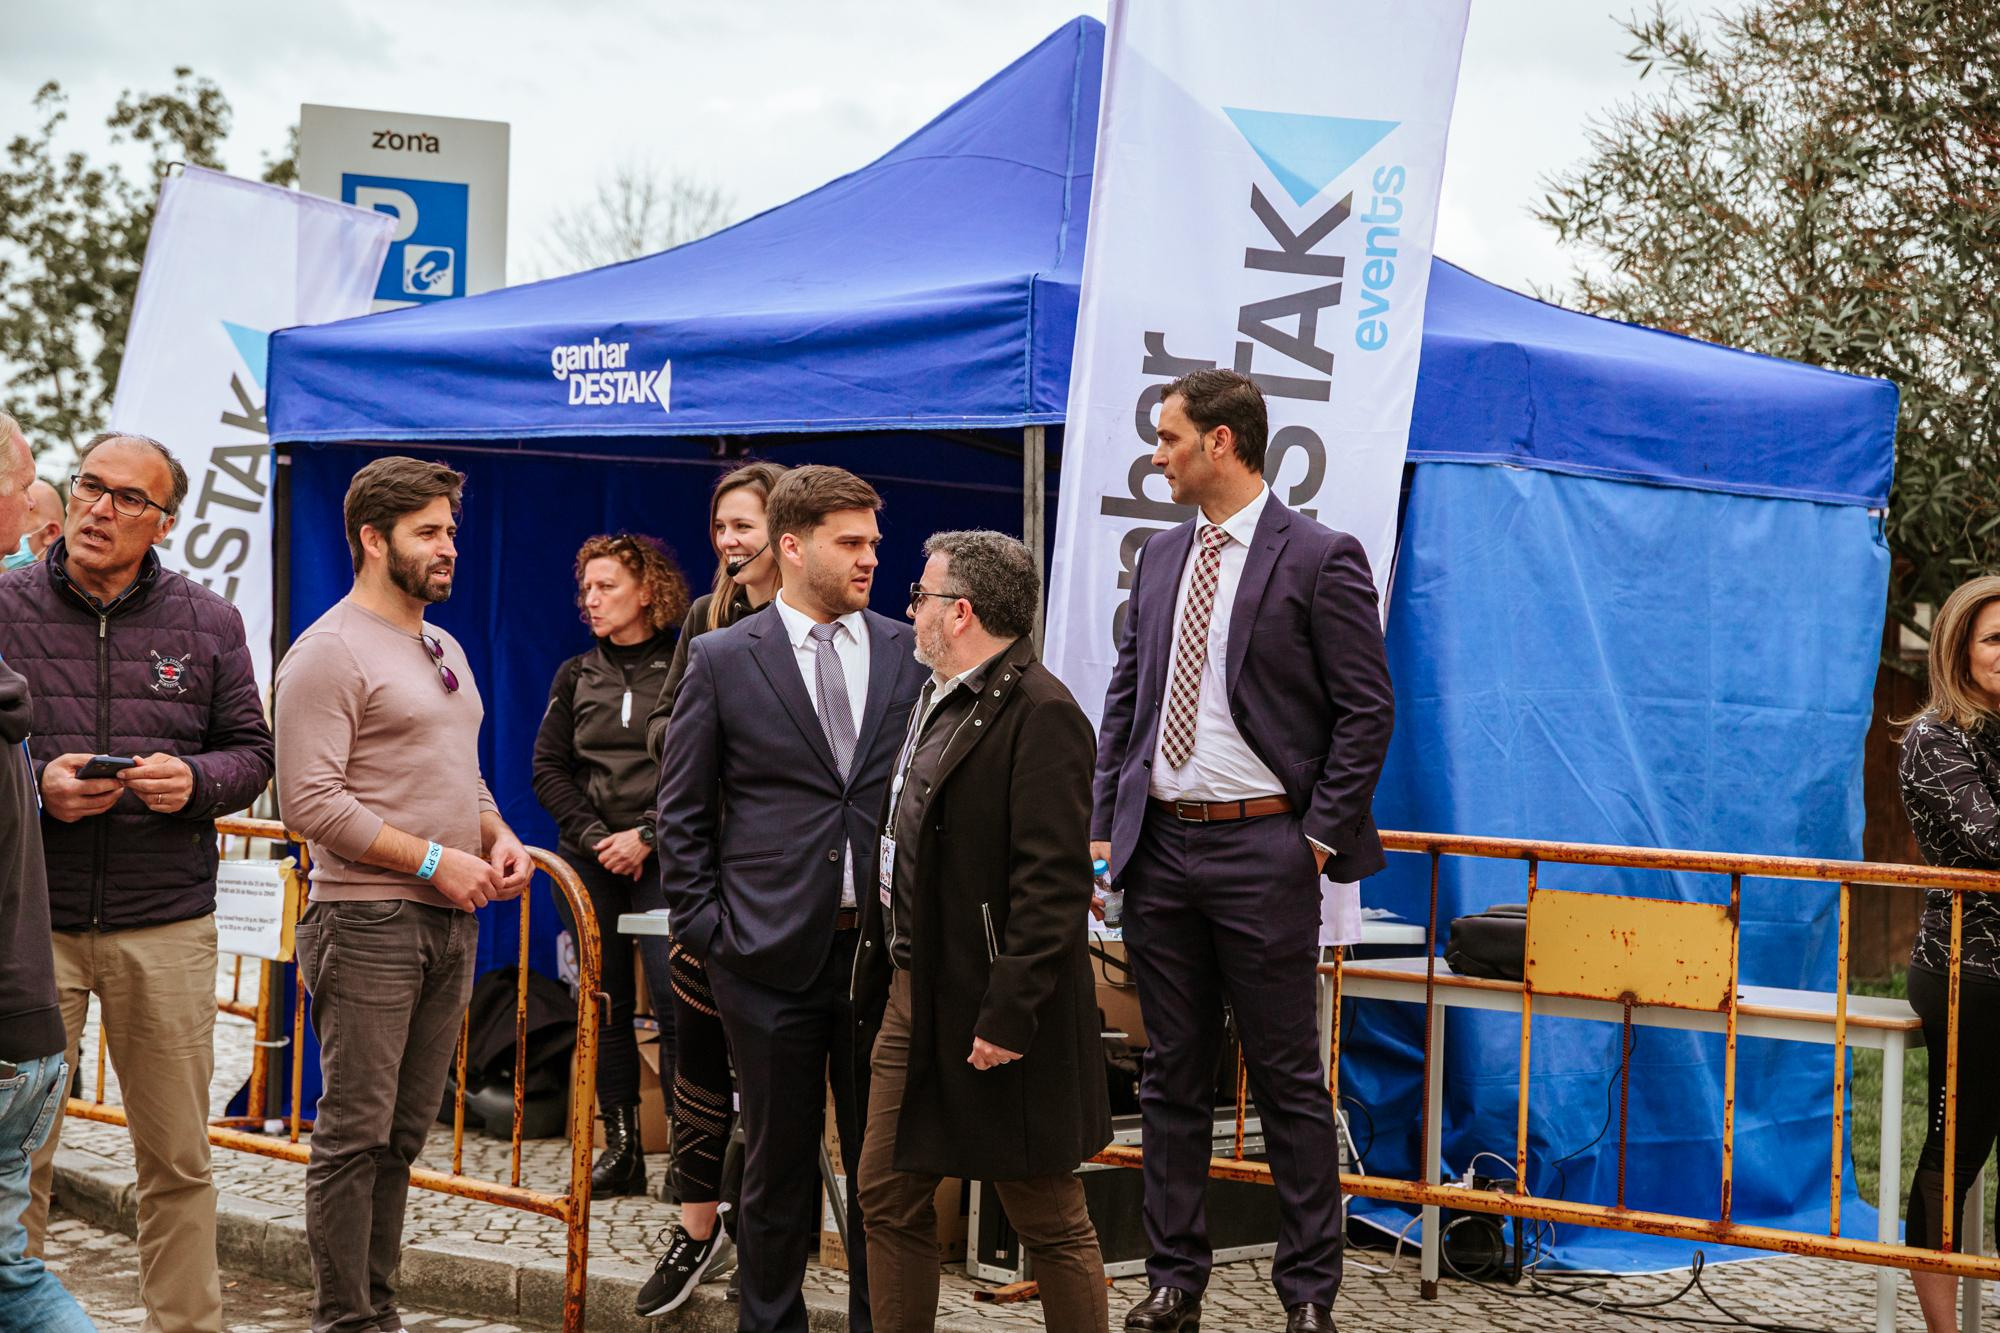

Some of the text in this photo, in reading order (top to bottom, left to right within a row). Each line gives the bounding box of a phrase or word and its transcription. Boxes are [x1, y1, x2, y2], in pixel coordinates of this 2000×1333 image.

[372, 130, 441, 154] zona
[1355, 165, 1406, 352] events
[551, 336, 630, 381] ganhar
[568, 370, 658, 405] DESTAK
[1232, 181, 1354, 520] STAK
[180, 371, 269, 604] STAK
